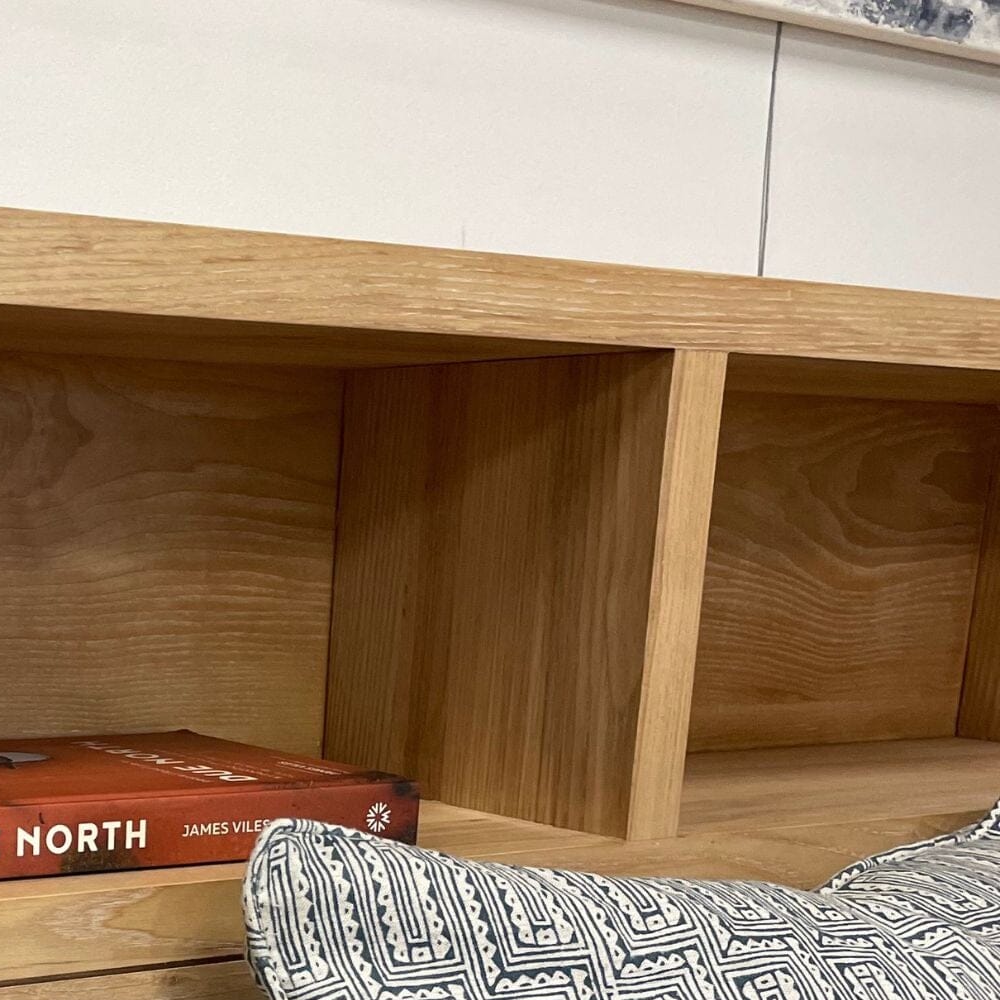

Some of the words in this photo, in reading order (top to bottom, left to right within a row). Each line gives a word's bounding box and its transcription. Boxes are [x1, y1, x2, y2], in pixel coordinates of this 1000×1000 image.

[70, 741, 184, 766] NORTH
[174, 765, 259, 782] DUE
[16, 819, 147, 857] NORTH
[182, 822, 229, 838] JAMES
